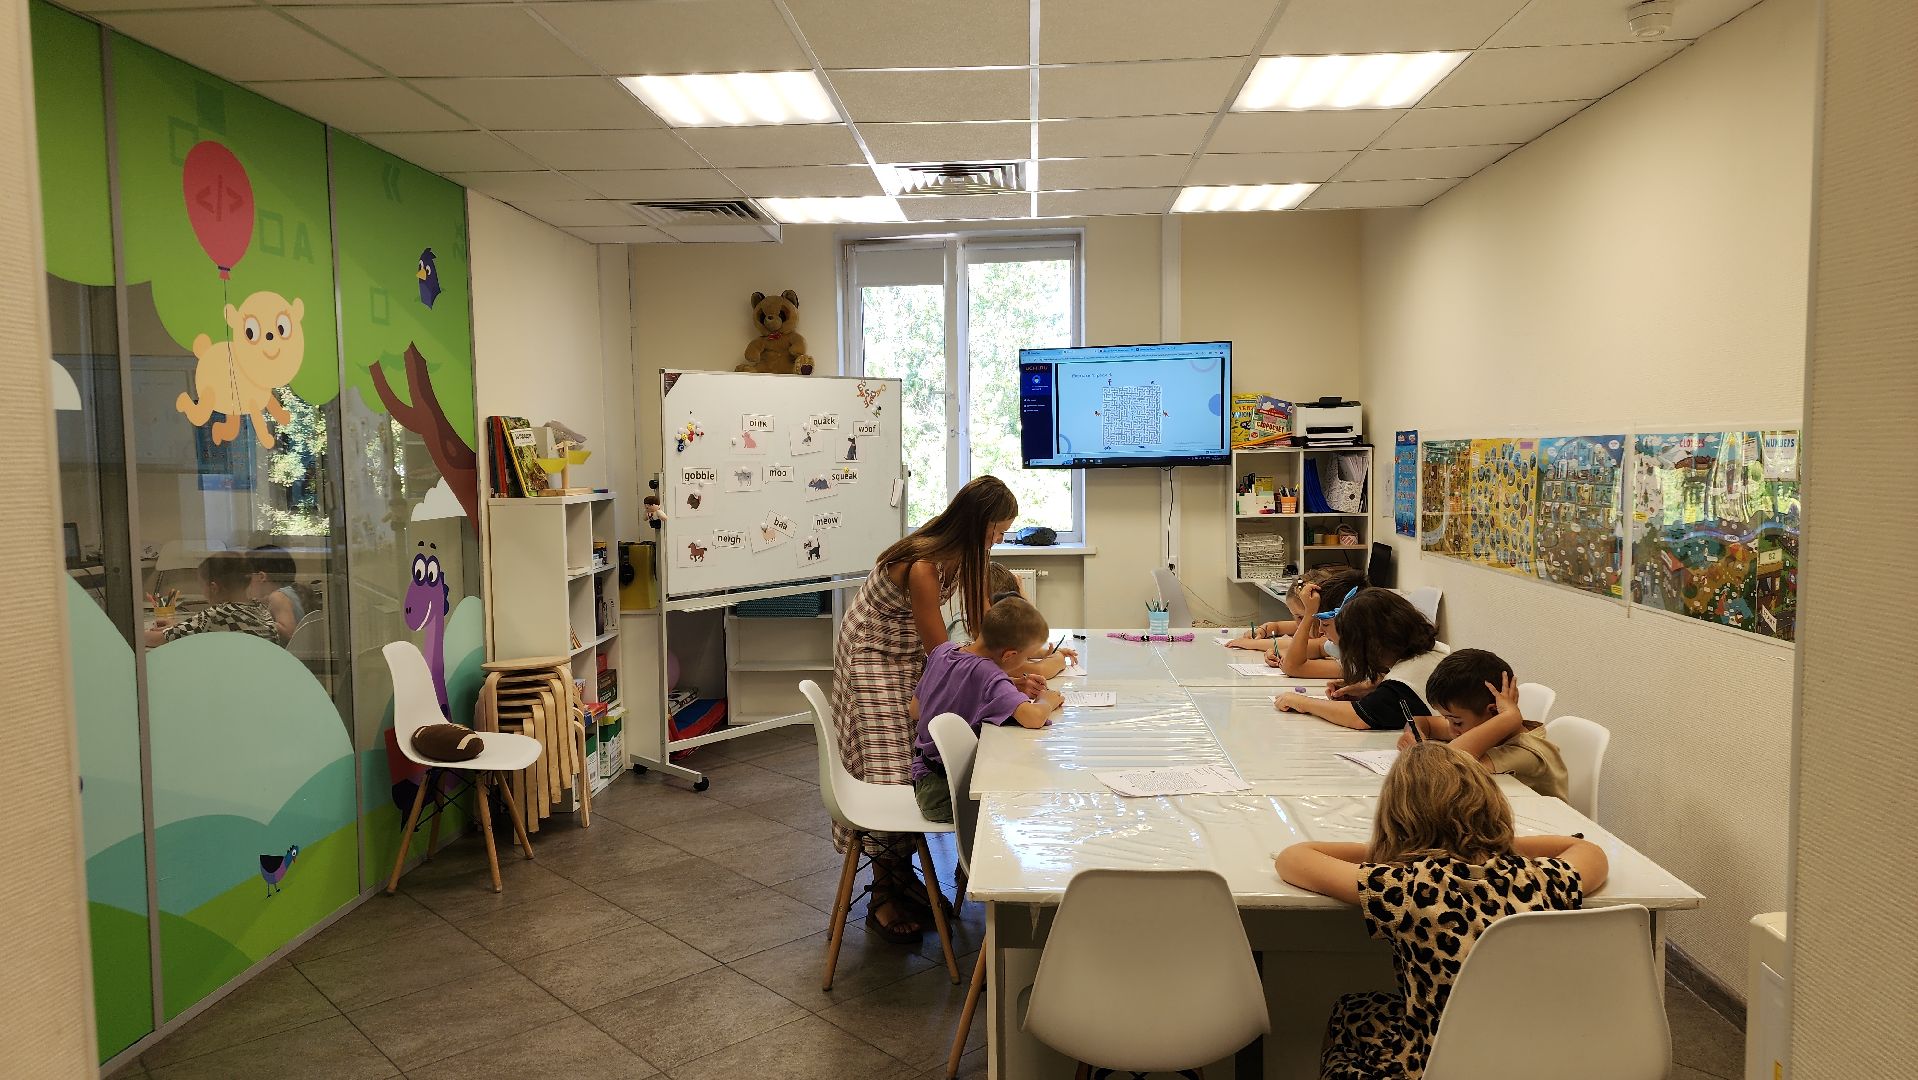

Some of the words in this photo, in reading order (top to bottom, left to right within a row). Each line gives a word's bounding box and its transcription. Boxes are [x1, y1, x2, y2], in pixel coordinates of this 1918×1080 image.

[813, 417, 836, 427] quack
[858, 424, 877, 433] woof
[1680, 438, 1705, 448] CLOTES
[684, 469, 715, 481] gobble
[769, 469, 787, 477] moo
[831, 472, 858, 481] squeak
[773, 517, 788, 531] baa
[816, 516, 839, 526] meow
[717, 534, 741, 545] neigh
